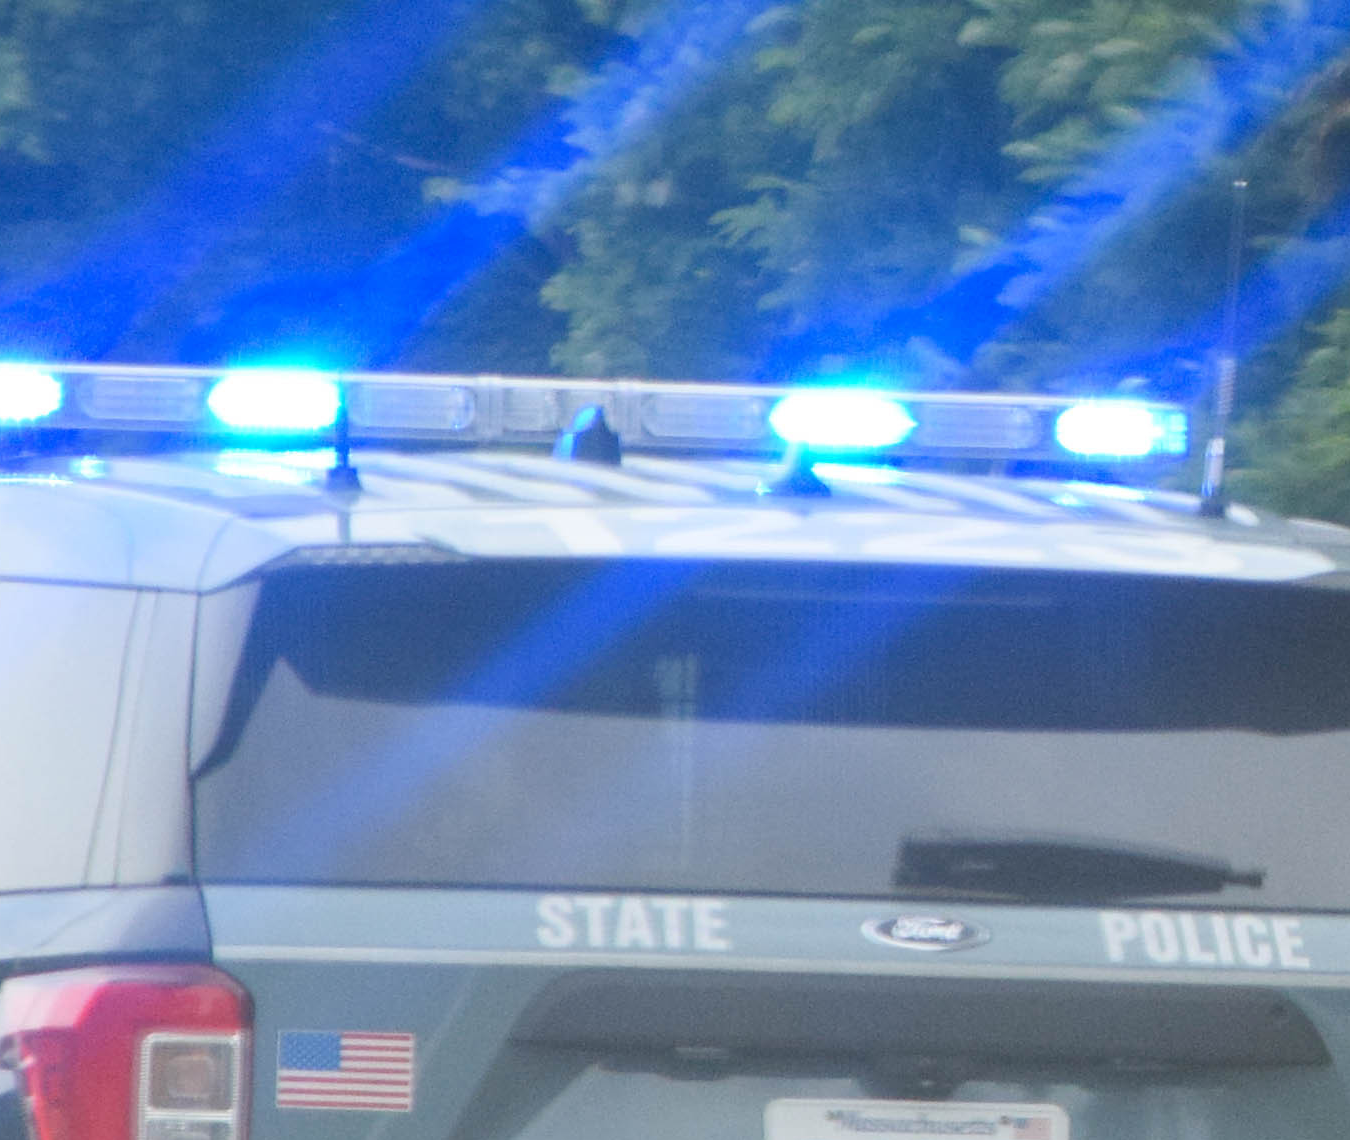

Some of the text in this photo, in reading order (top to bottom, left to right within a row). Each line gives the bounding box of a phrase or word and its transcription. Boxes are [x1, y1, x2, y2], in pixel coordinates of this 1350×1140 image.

[536, 893, 1311, 968] STATE POLICE
[891, 912, 966, 941] Ford
